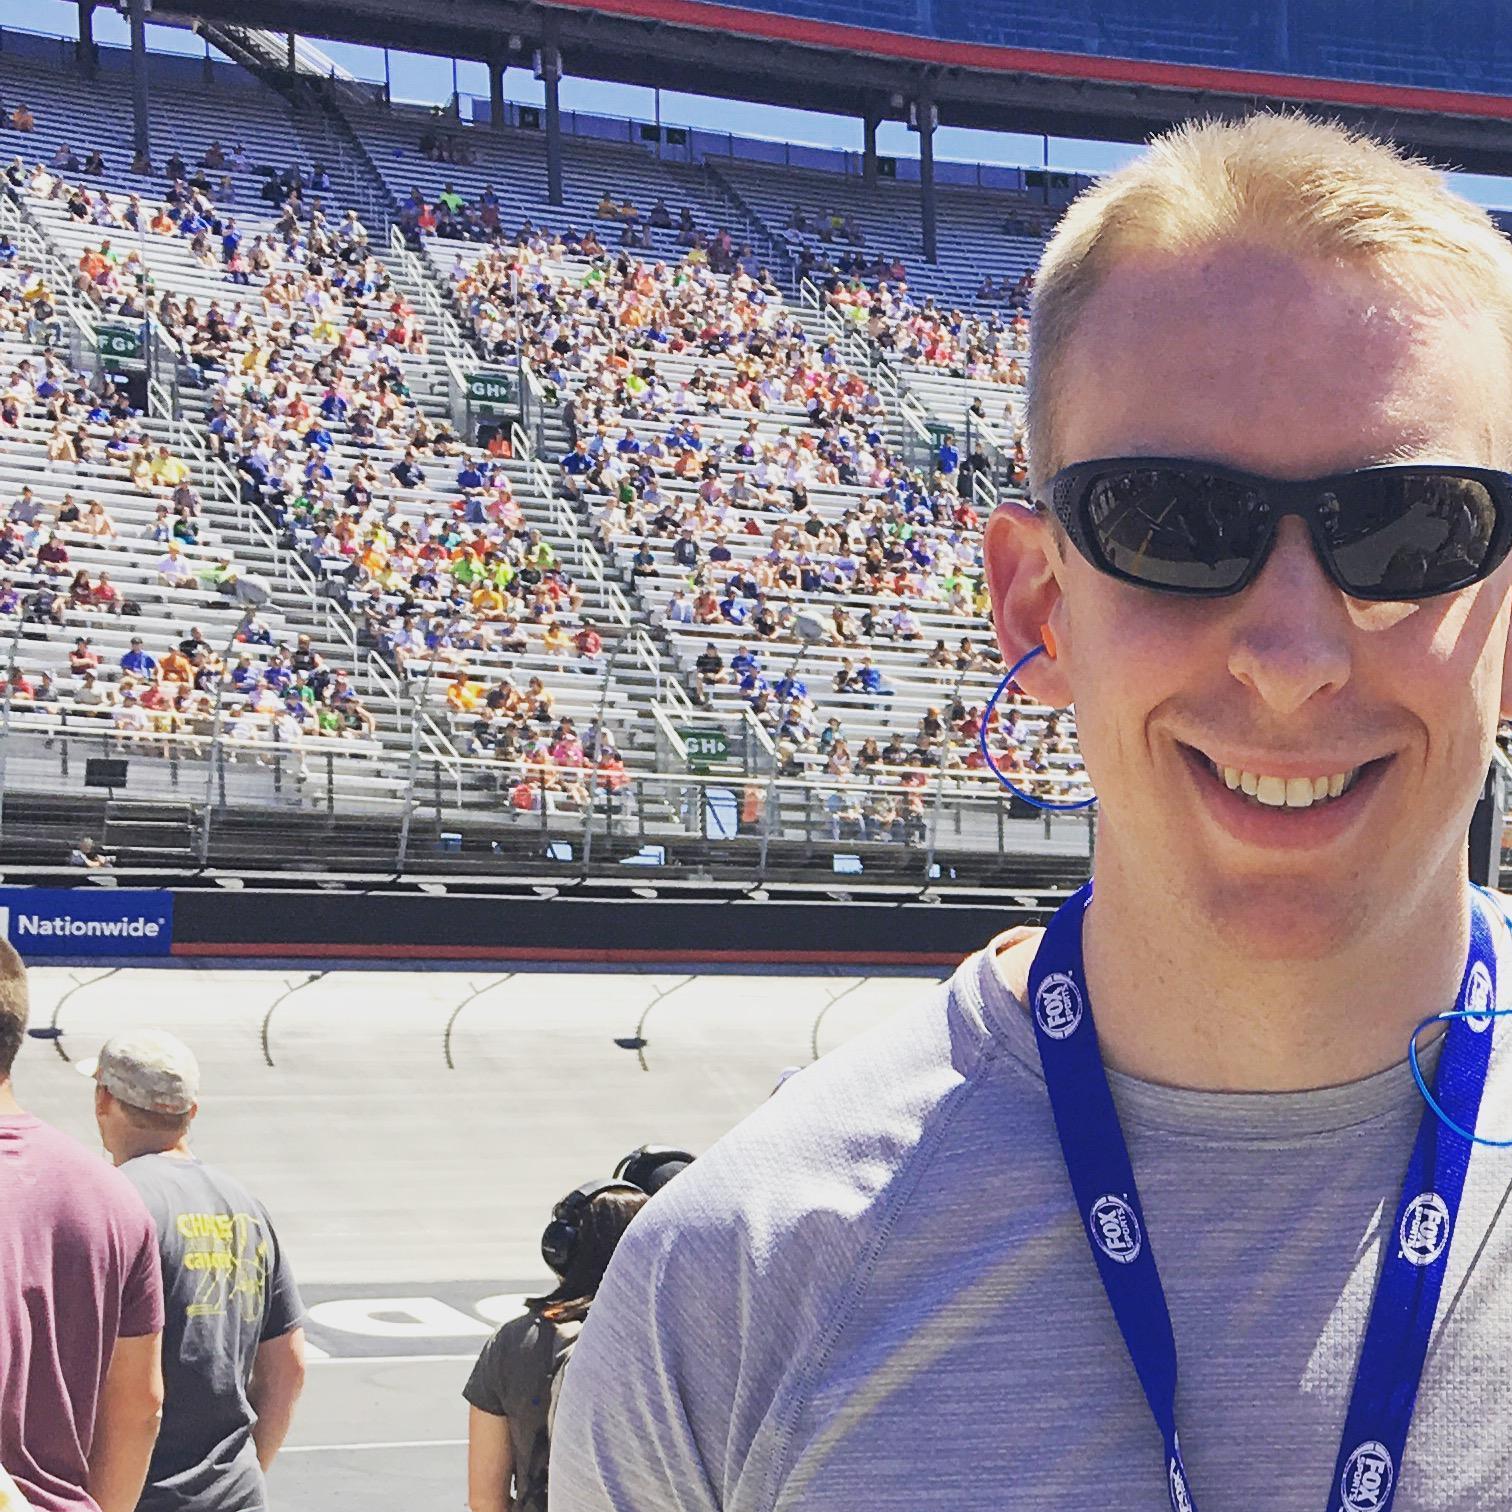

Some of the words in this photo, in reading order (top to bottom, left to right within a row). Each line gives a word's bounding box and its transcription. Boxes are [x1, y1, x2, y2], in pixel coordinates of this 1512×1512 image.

[472, 382, 500, 397] GH
[684, 737, 717, 754] GH
[18, 914, 160, 937] Nationwide
[1042, 985, 1067, 1029] FOX
[1061, 983, 1075, 1022] SPORTS
[1097, 1209, 1127, 1249] FOX
[1116, 1206, 1134, 1248] SPORTS
[1415, 1208, 1442, 1252] FOX
[1348, 1455, 1366, 1502] SPORTS
[1357, 1457, 1387, 1505] FOX
